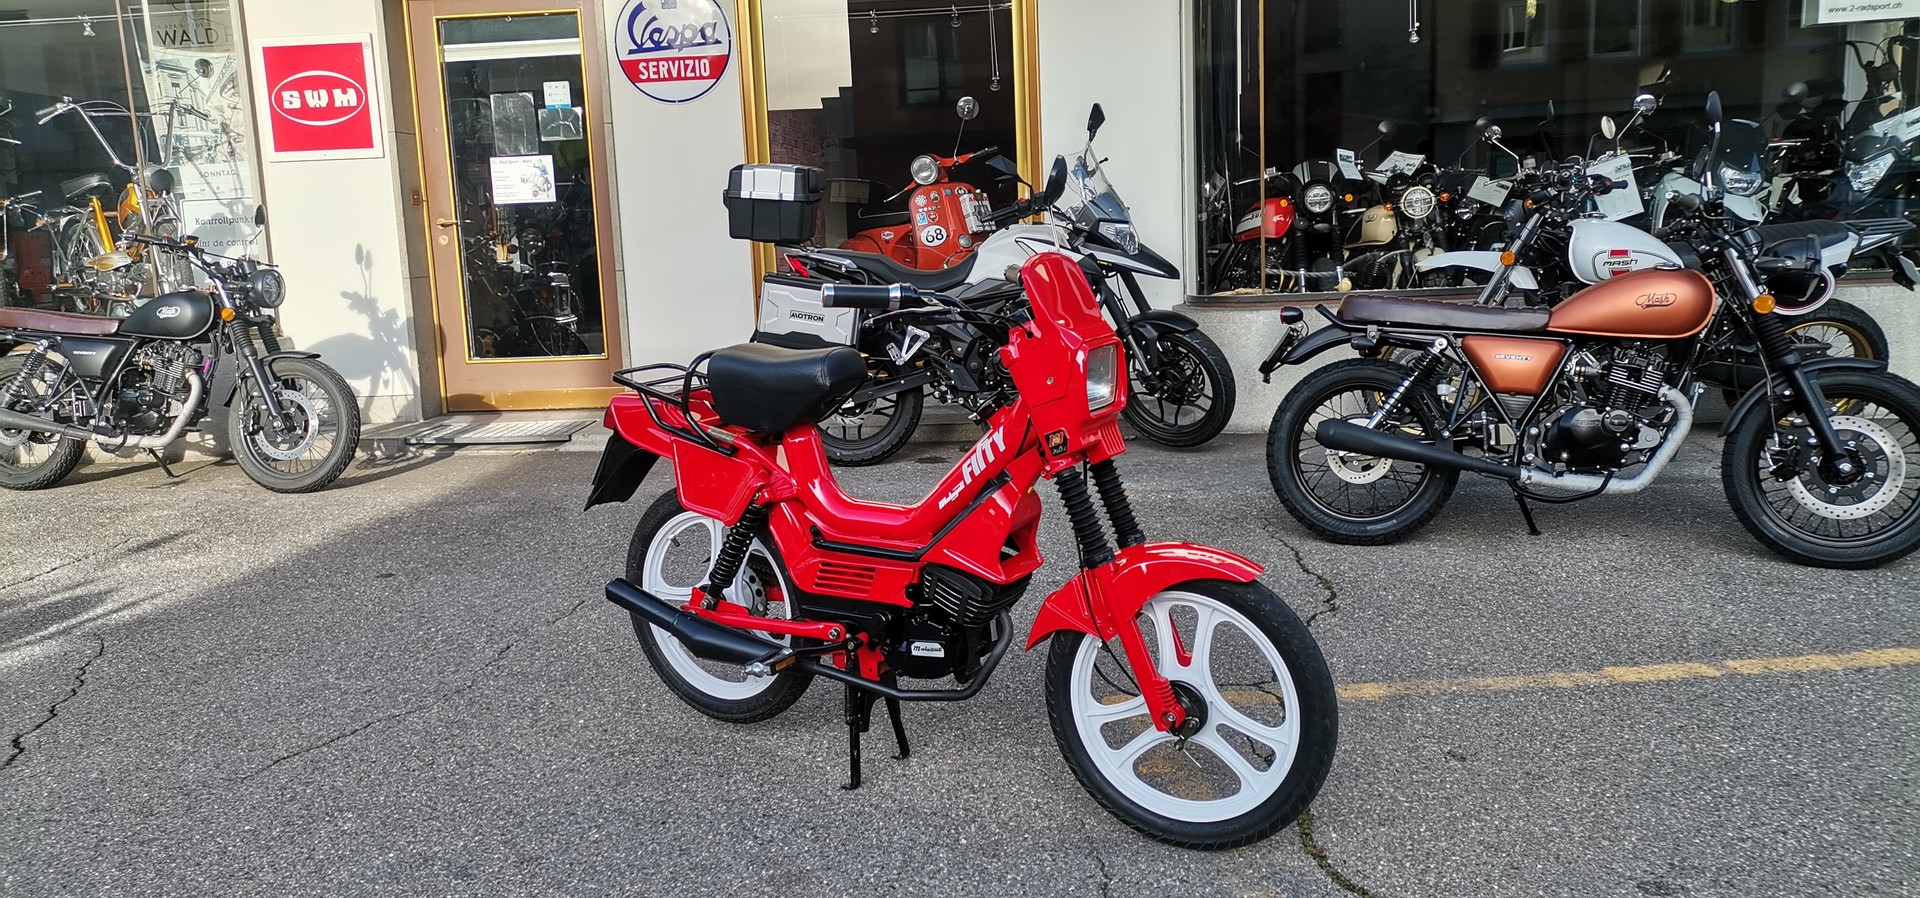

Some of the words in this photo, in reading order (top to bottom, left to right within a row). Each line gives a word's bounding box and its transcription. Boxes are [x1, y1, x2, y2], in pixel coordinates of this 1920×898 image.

[1828, 3, 1903, 13] www.2-radsport.ch
[627, 2, 722, 54] Vespa
[638, 59, 710, 79] SERVIZIO
[281, 87, 357, 109] SWM
[926, 228, 944, 243] 68
[791, 312, 824, 322] MOTRON
